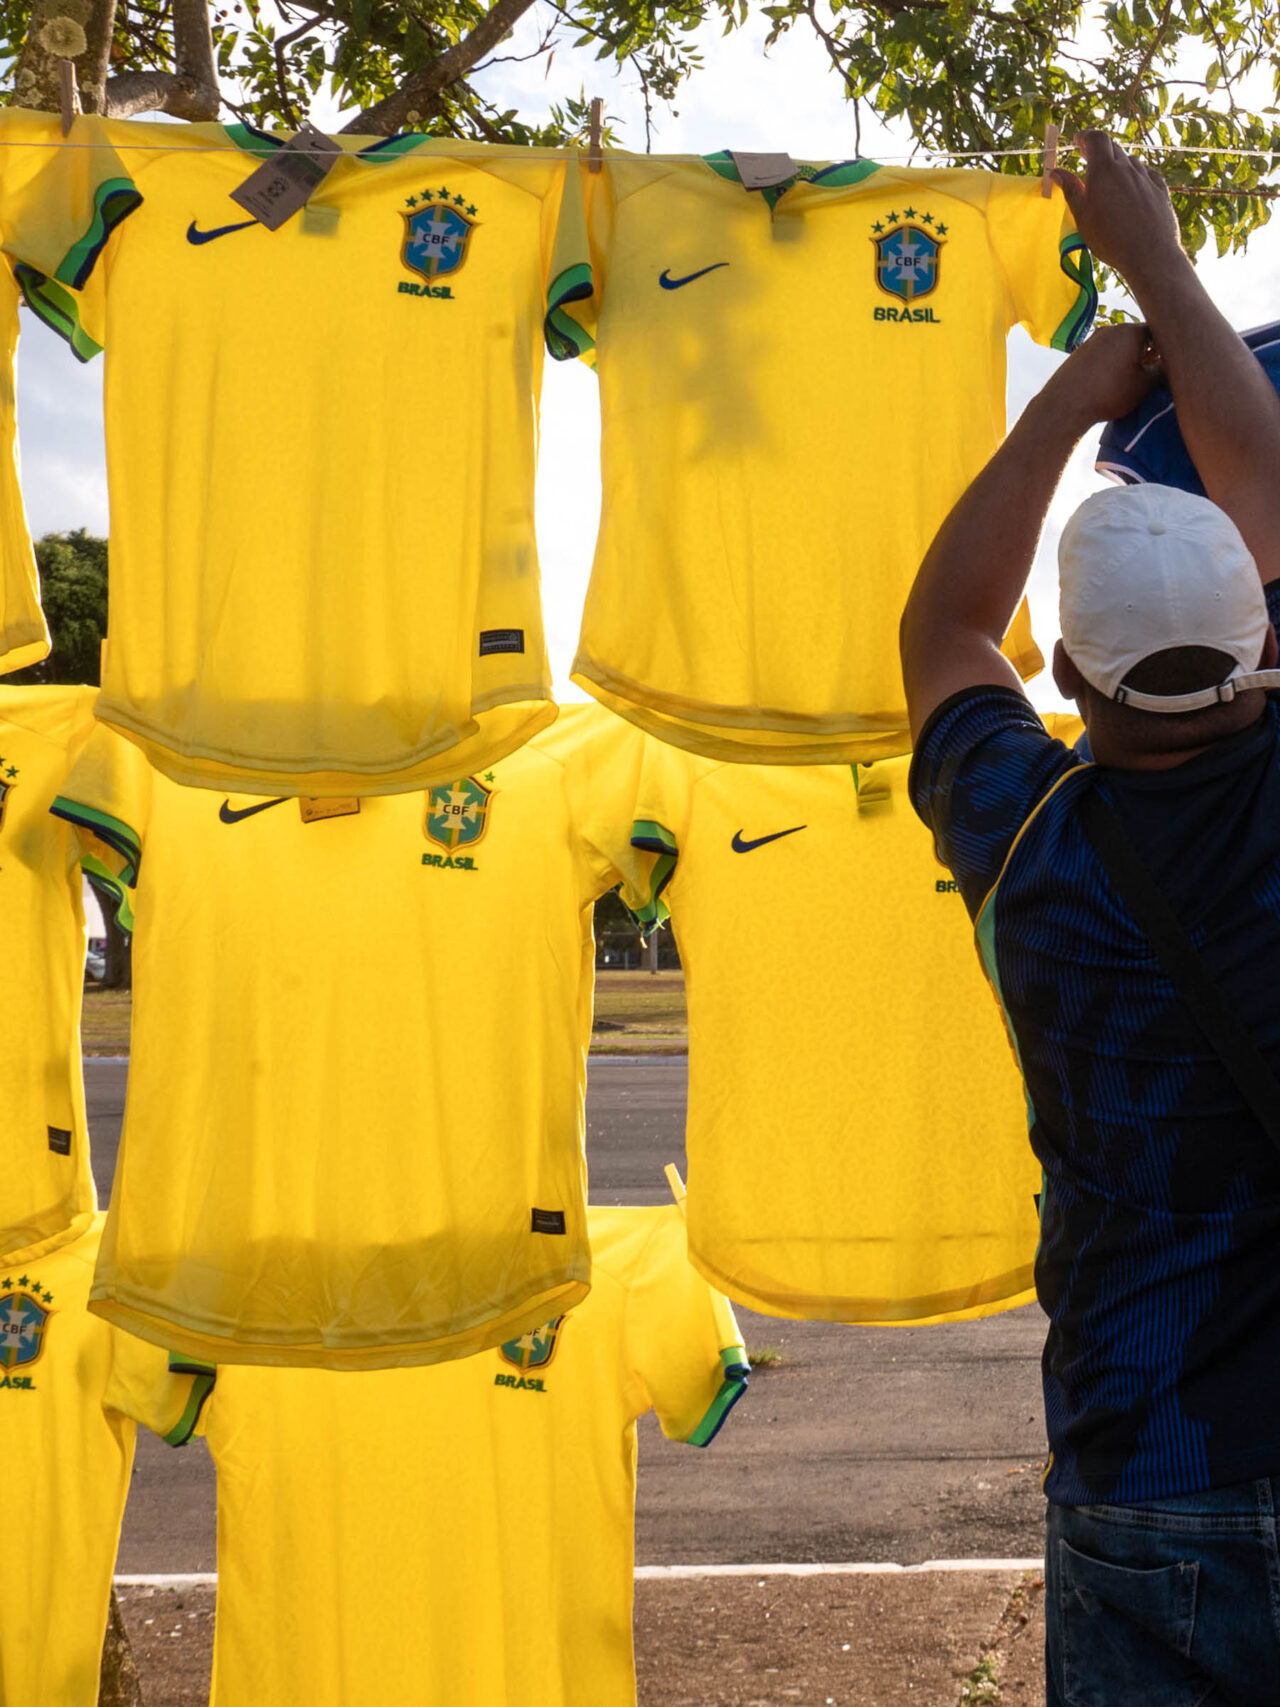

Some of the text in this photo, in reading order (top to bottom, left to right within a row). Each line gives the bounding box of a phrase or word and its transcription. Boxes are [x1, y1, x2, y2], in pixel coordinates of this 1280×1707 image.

[423, 233, 450, 245] CBF
[895, 256, 921, 267] CBF
[397, 281, 455, 299] BRASIL
[873, 306, 941, 323] BRASIL
[443, 804, 470, 815] CBF
[421, 853, 478, 871] BRASIL
[936, 880, 960, 893] BR
[2, 1323, 27, 1334] CBF
[0, 1376, 36, 1390] ASIL
[494, 1373, 547, 1392] BRASIL
